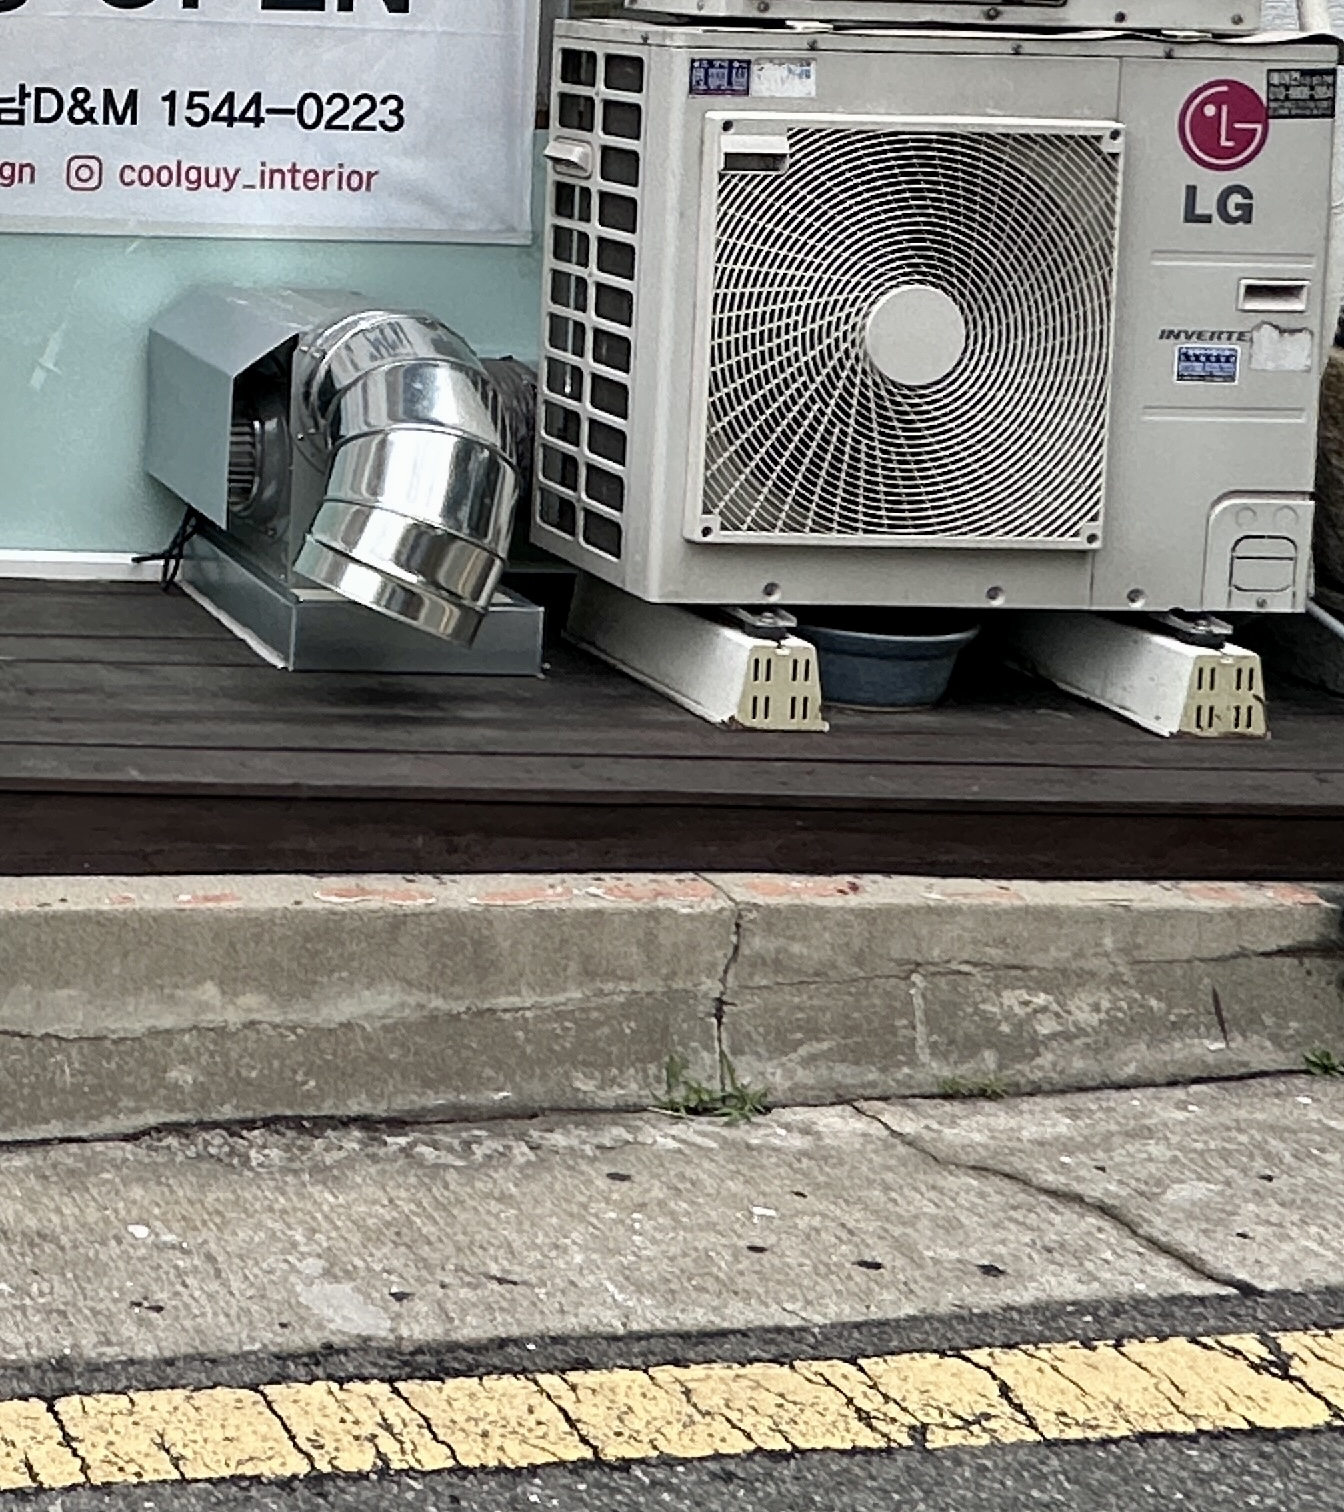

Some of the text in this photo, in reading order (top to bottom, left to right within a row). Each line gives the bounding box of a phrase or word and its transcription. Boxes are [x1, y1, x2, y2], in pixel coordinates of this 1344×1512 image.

[161, 92, 407, 133] 1544-0223
[118, 158, 379, 195] coolguy_interior
[1183, 184, 1255, 226] LG
[1158, 328, 1252, 342] INVERTE
